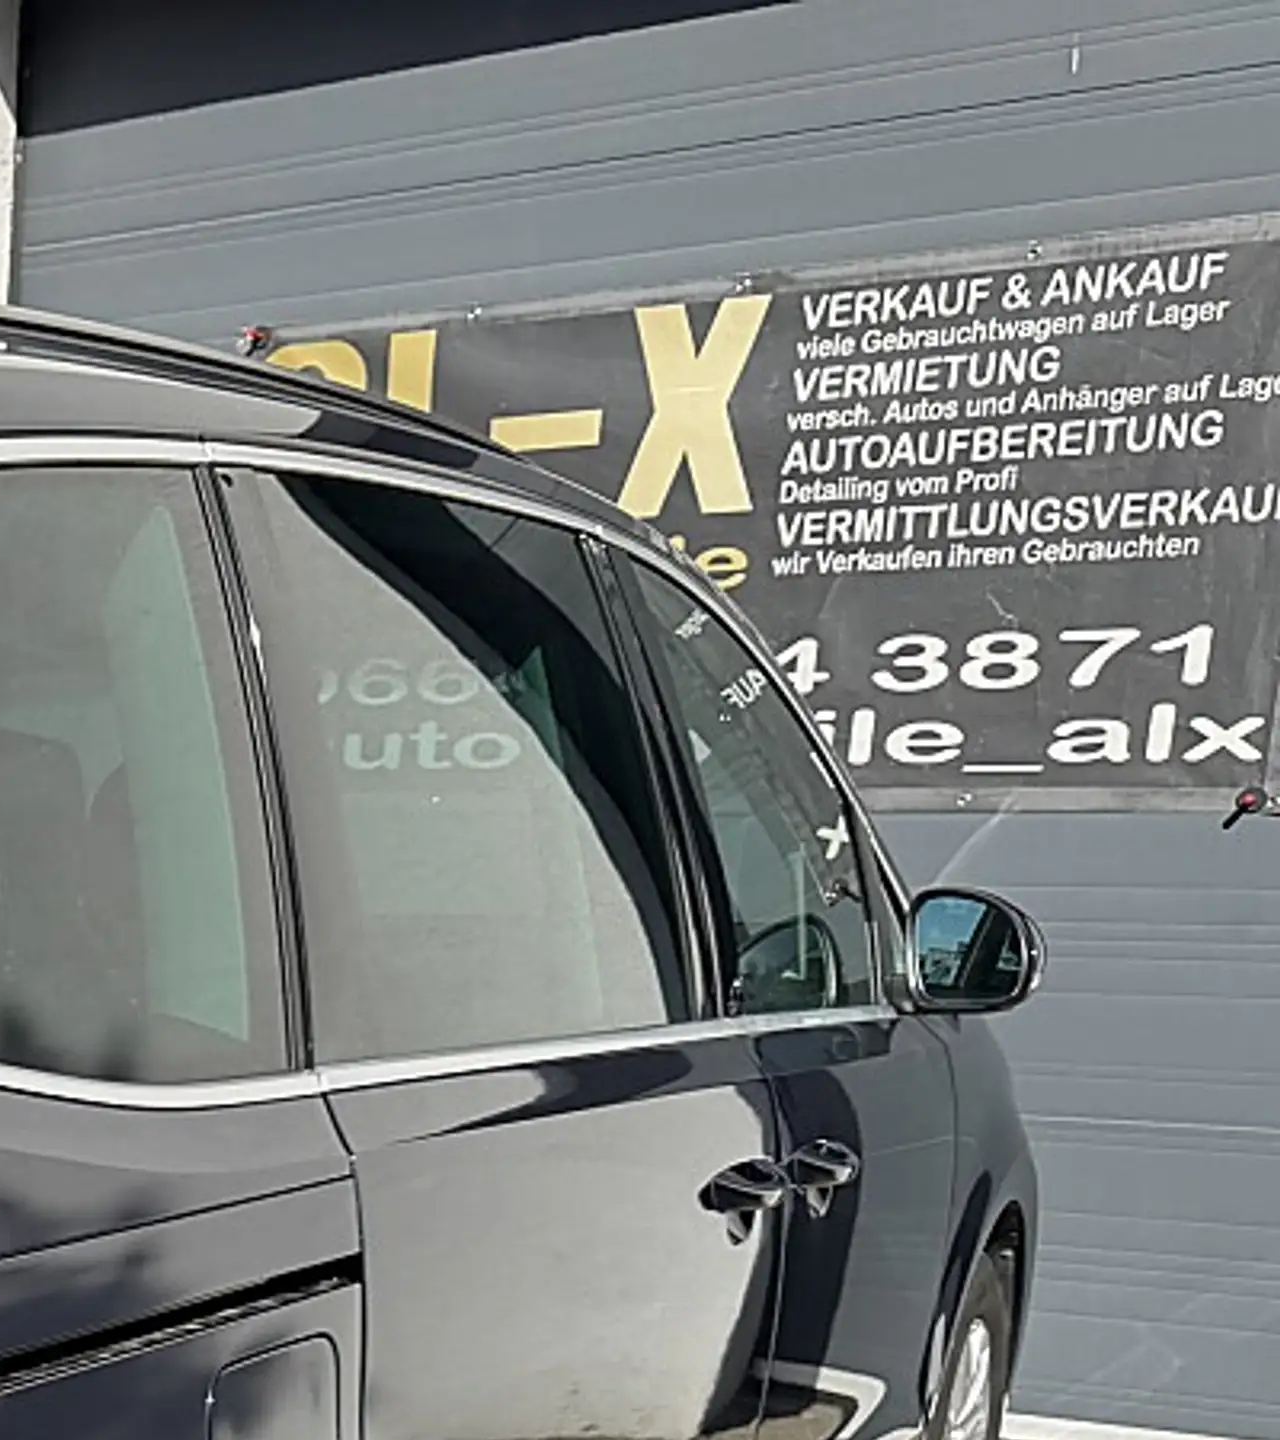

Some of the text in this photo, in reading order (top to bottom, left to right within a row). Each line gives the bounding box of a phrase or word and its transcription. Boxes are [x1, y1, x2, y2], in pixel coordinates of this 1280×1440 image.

[802, 252, 1230, 331] VERKAUF & ANKAUF
[796, 300, 1231, 361] viele Gebrauchtwagen auf Lager
[786, 400, 878, 432] versch.
[883, 396, 959, 426] Autos
[965, 390, 1017, 419] und
[1021, 383, 1161, 415] Anhänger
[1164, 373, 1215, 404] auf
[793, 345, 1062, 403] VERMIETUNG
[780, 408, 1225, 476] AUTOAUFBEREITUNG
[779, 464, 1019, 505] Detailing vom Profi
[777, 482, 1280, 549] VERMITTLUNGSVERKAU
[771, 533, 1201, 577] wir Verkaufen ihren Gebrauchten
[870, 622, 1216, 693] 3871
